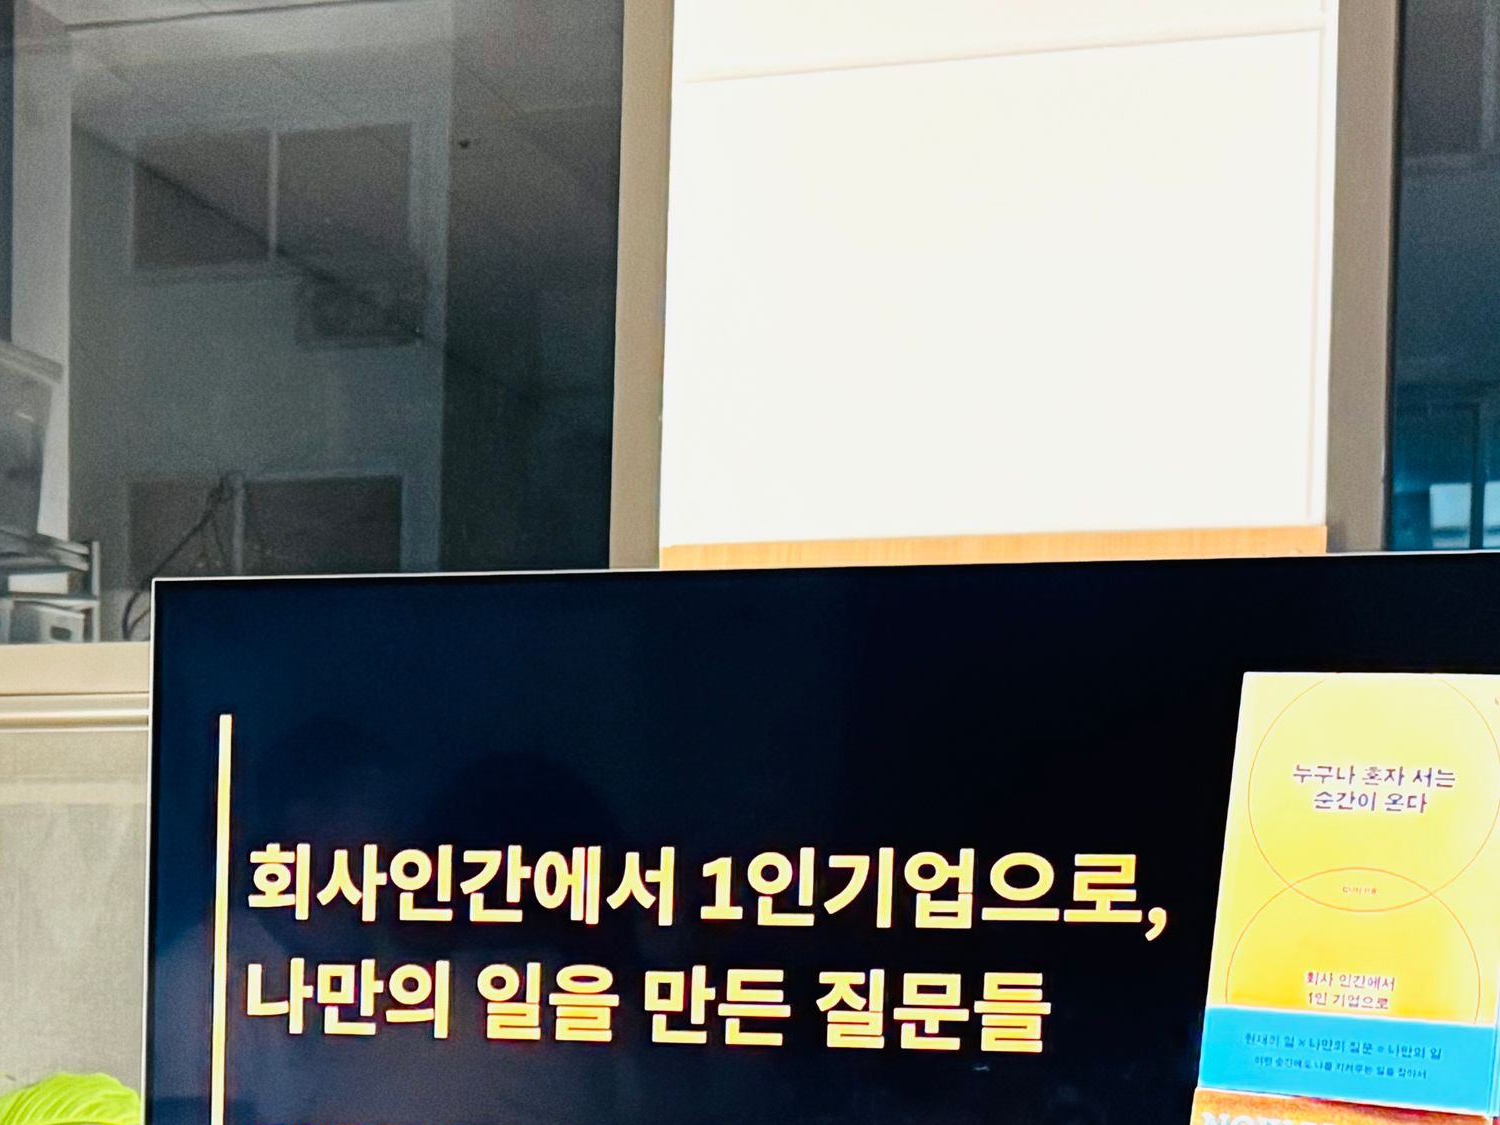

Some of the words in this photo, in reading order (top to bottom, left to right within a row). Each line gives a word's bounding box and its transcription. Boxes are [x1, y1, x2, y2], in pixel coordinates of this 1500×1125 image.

[1293, 764, 1356, 785] 누구나
[1362, 766, 1405, 786] 혼자
[1412, 767, 1456, 788] 서는
[1314, 791, 1376, 811] 순간이
[1384, 793, 1427, 814] 온다
[248, 843, 675, 926] 회사인간에서
[700, 846, 1167, 941] 1인기업으로,
[1307, 971, 1333, 987] 회사
[1338, 973, 1396, 992] 인간에서
[247, 957, 450, 1039] 나만의
[477, 962, 619, 1042] 일을
[644, 965, 791, 1046] 만든
[816, 968, 1052, 1053] 질문들
[1332, 993, 1389, 1010] 기업으로
